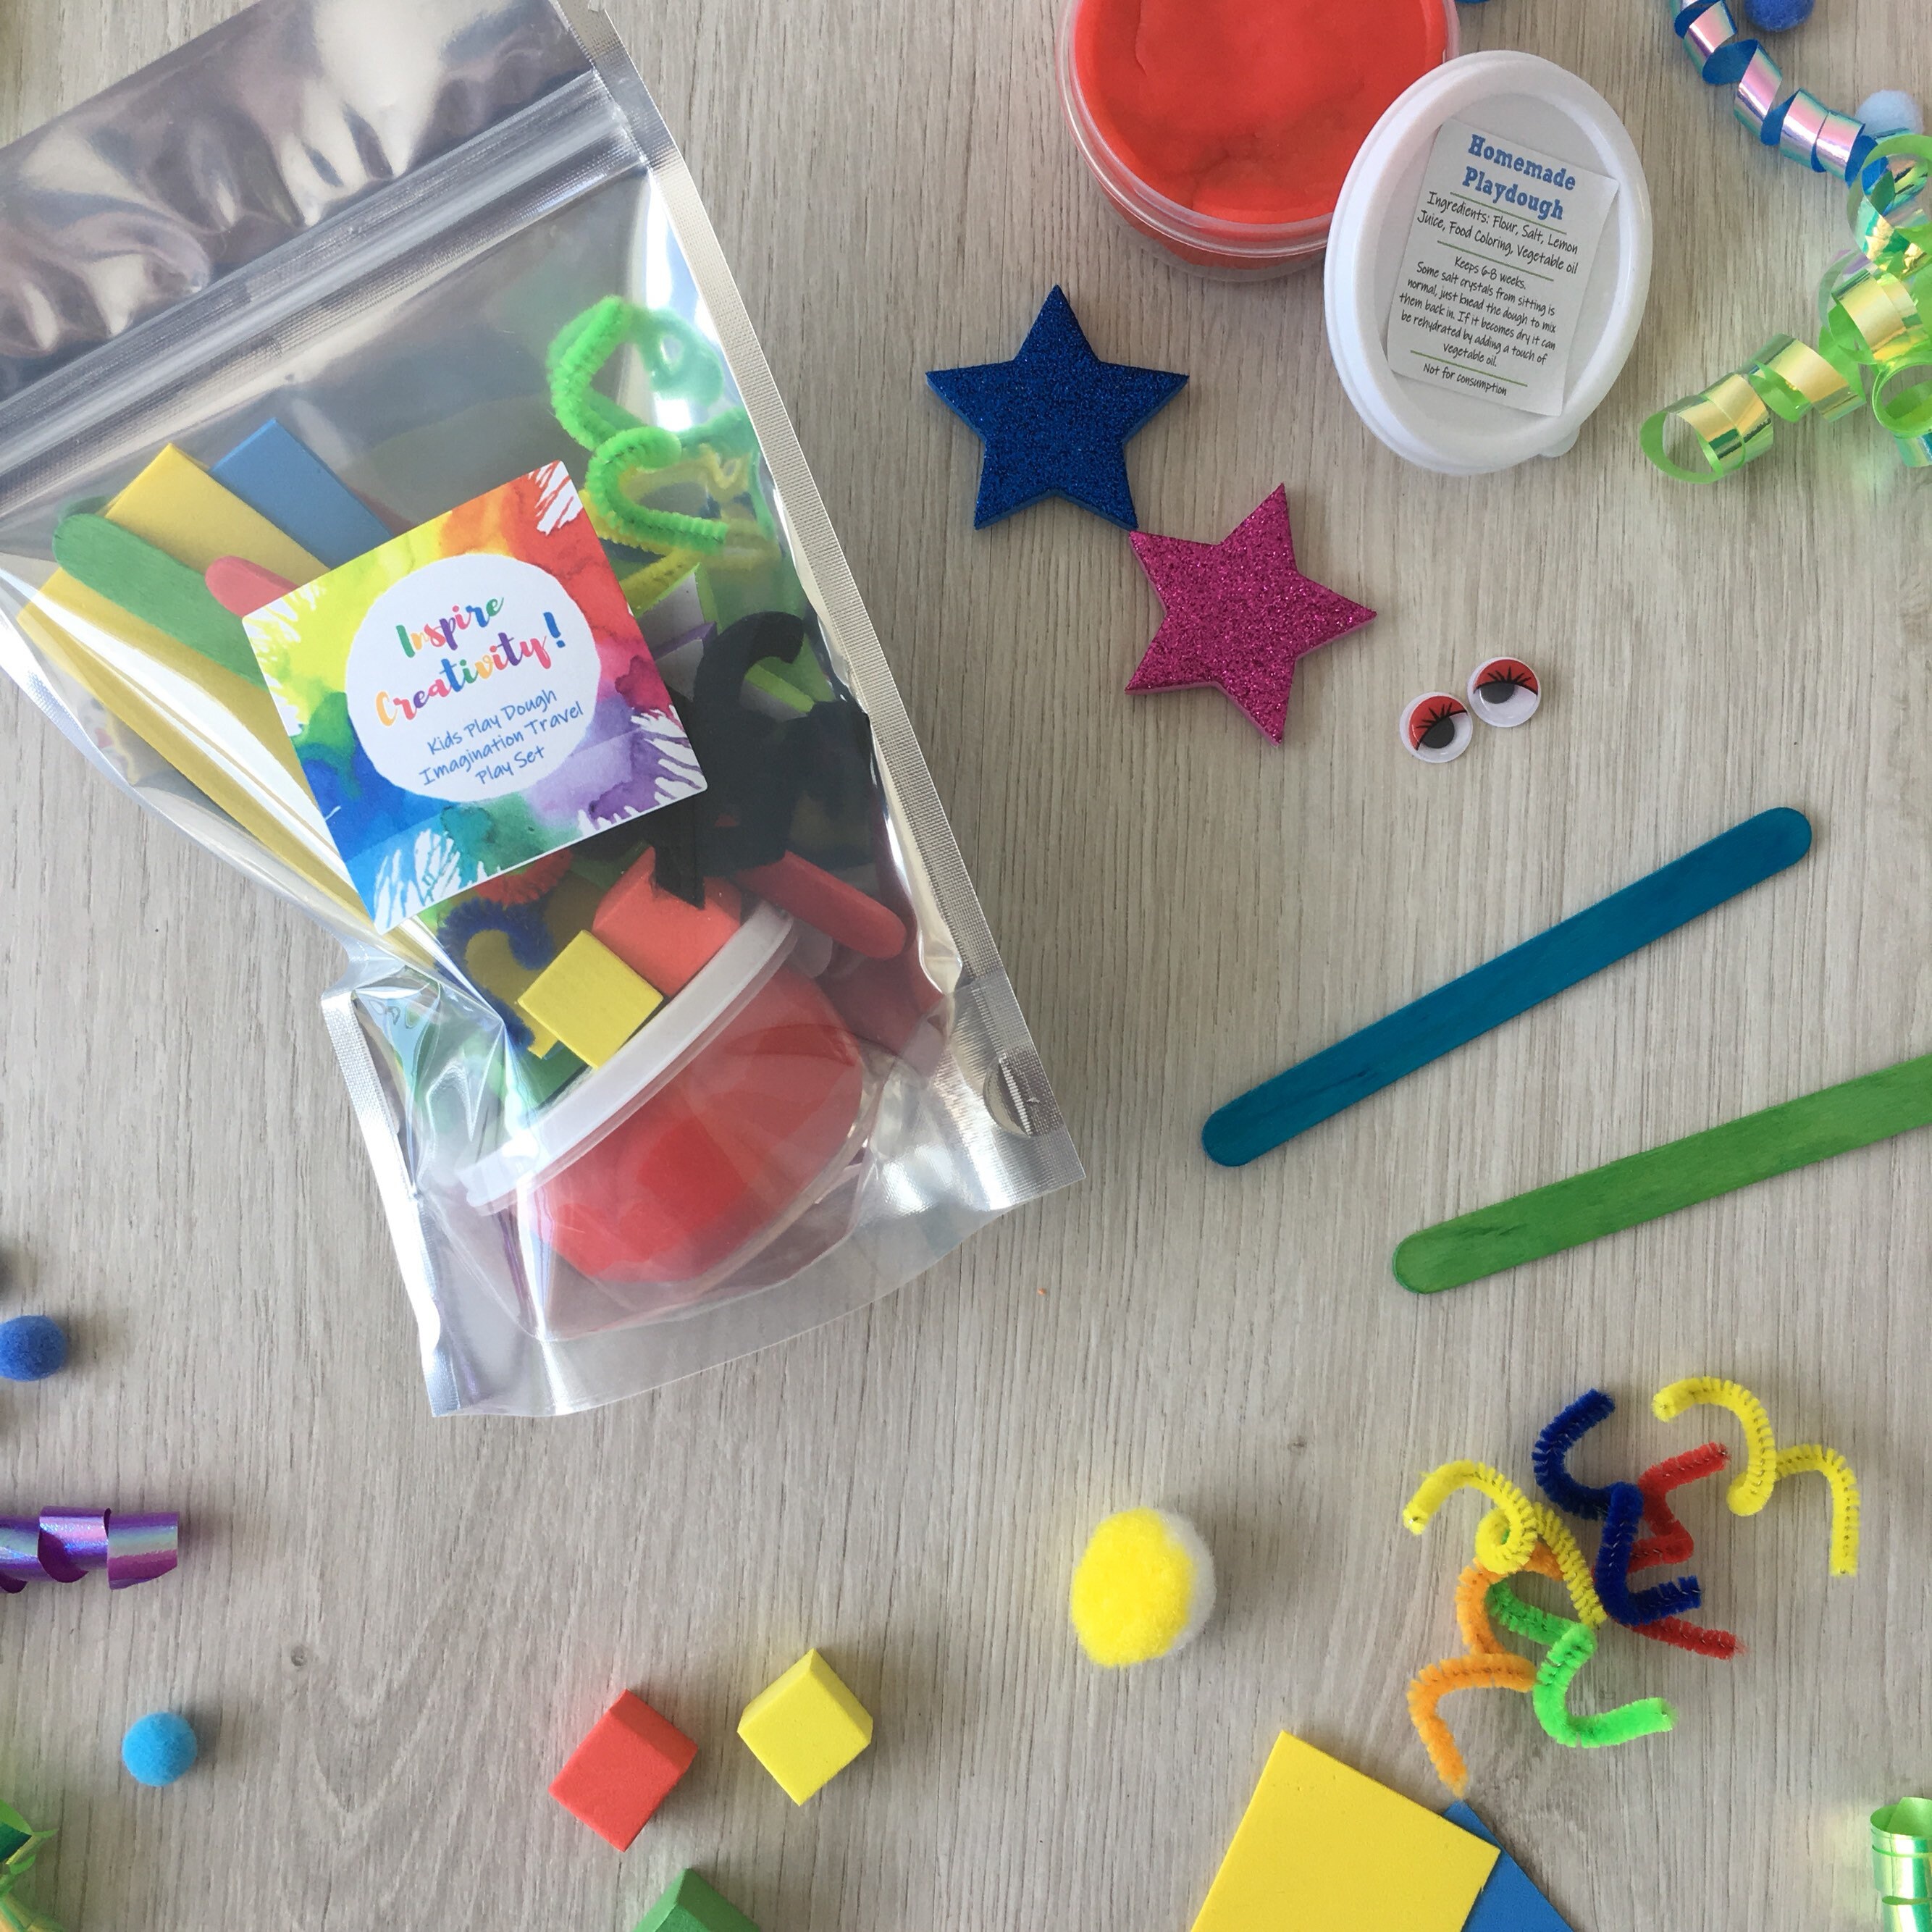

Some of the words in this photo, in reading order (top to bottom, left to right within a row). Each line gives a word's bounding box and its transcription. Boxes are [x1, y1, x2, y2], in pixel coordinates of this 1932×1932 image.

[1468, 133, 1576, 191] Homemade
[1461, 165, 1563, 221] Playdough
[1416, 209, 1446, 232] Juice,
[1448, 220, 1474, 239] Food
[1474, 229, 1514, 257] Coloring,
[1516, 243, 1565, 270] Vegetable
[1566, 261, 1579, 274] oil
[1427, 190, 1490, 224] Ingredients:
[1492, 214, 1519, 236] Flour,
[1521, 224, 1545, 245] Salt,
[1547, 233, 1578, 255] Lemon
[1416, 261, 1440, 279] Some
[1440, 272, 1460, 285] salt
[1459, 277, 1494, 297] crystals
[1495, 286, 1516, 304] from
[1517, 295, 1547, 317] sitting
[1547, 303, 1555, 316] is
[1453, 256, 1479, 274] Keeps
[1480, 265, 1498, 281] 6-8
[1499, 272, 1526, 290] weeks.
[1398, 292, 1423, 309] them
[1424, 298, 1446, 316] back
[1445, 306, 1456, 320] in.
[1456, 310, 1471, 325] If
[1470, 314, 1480, 327] it
[1480, 316, 1515, 338] becomes
[1516, 328, 1532, 345] dry
[1531, 335, 1541, 345] it
[1540, 339, 1556, 351] can
[1407, 278, 1438, 298] normal,
[1437, 285, 1459, 302] just
[1458, 292, 1485, 311] knead
[1485, 302, 1502, 316] the
[1502, 306, 1529, 327] dough
[1529, 316, 1540, 329] to
[1542, 321, 1557, 334] mix
[1400, 308, 1412, 323] be
[1413, 316, 1463, 338] rehydrated
[1462, 328, 1474, 345] by
[1474, 333, 1502, 356] adding
[1503, 345, 1510, 354] a
[1511, 345, 1536, 362] touch
[1536, 353, 1548, 366] of
[1443, 343, 1485, 363] vegetable
[1485, 354, 1498, 368] oil.
[1423, 363, 1441, 376] Not
[1441, 366, 1456, 380] for
[1456, 374, 1507, 396] consumption
[395, 597, 505, 659] Inspire
[419, 731, 525, 786] Imagination
[523, 700, 584, 735] Travel
[427, 730, 463, 755] Kids
[463, 714, 503, 738] Play
[500, 689, 558, 721] Dough
[474, 761, 515, 785] Play
[513, 745, 545, 769] Set
